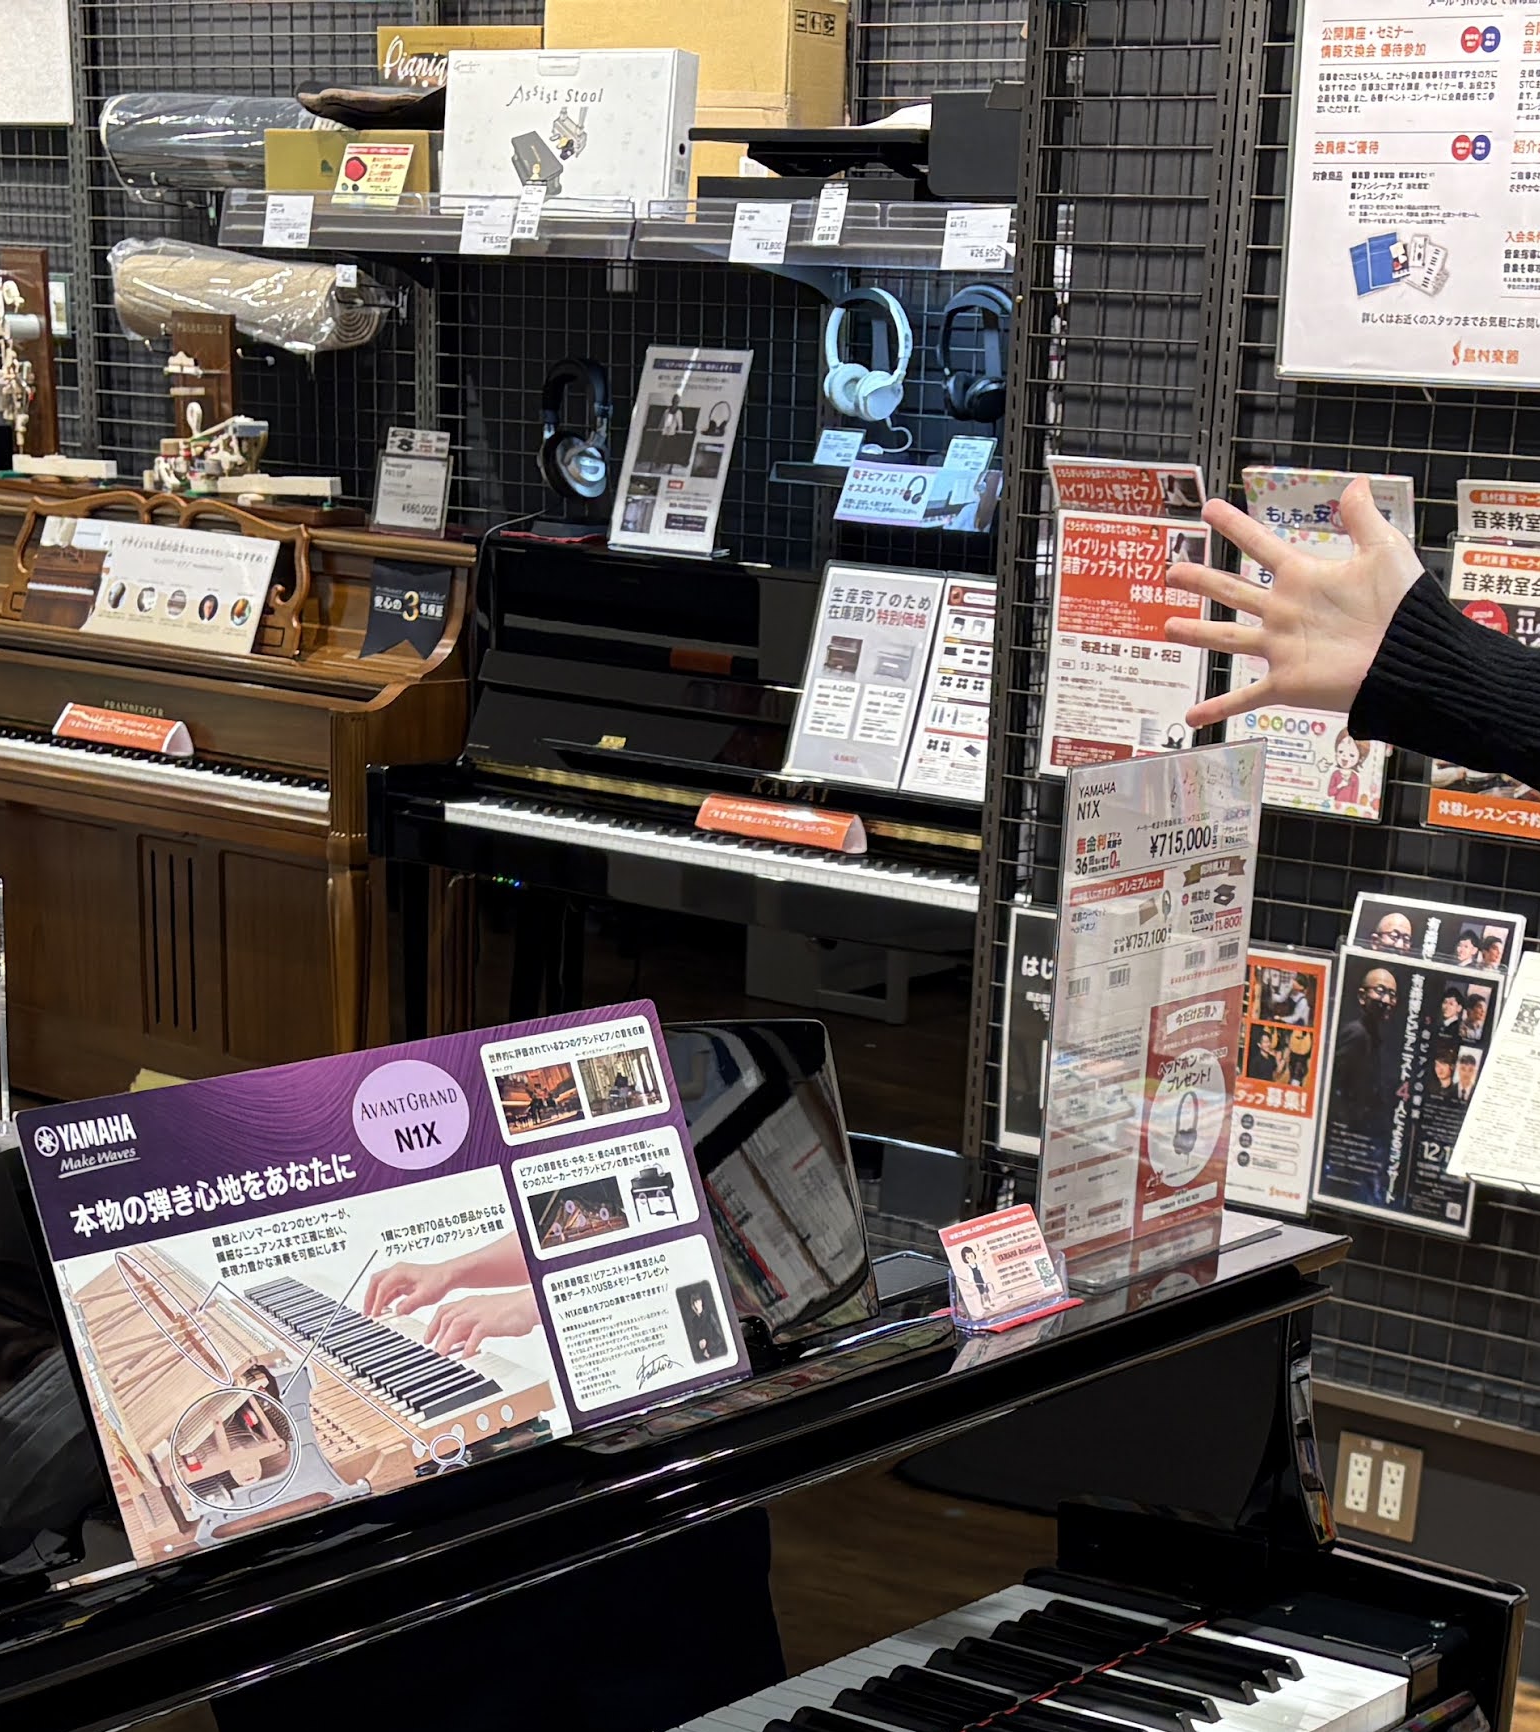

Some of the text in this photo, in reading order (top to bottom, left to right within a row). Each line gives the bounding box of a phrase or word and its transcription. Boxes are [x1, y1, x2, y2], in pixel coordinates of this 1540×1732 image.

[1321, 26, 1414, 41] 公開講座・セミナー
[1320, 43, 1427, 59] 情報交換会 優待参加
[506, 84, 605, 107] Assist Stool
[1314, 140, 1380, 155] 会員様ご優待
[1312, 171, 1344, 182] 対象商品
[1462, 348, 1520, 365] 島村楽器
[829, 586, 932, 612] 生産完了のため
[827, 602, 928, 631] 在庫限り特別価格
[1080, 639, 1182, 664] 毎週土曜・日曜・祝日
[751, 775, 830, 804] KAWAI
[1078, 780, 1117, 798] YAMAHA
[1076, 799, 1101, 822] N1X
[1149, 825, 1212, 860] ¥715,000
[1074, 855, 1088, 876] 36
[1125, 927, 1167, 951] ¥757,100
[487, 1024, 646, 1064] 世界的に評価されている2つのグランドピアノの音を収録
[1167, 1067, 1212, 1093] プレゼント!
[1233, 1085, 1308, 1114] タッフ募集!
[57, 1112, 138, 1154] YAMAHA
[393, 1121, 443, 1155] N1X
[60, 1145, 137, 1173] Make Waves
[522, 1147, 671, 1190] 6つのスピーカーでグランドピアノの豊かな響きを再現
[67, 1151, 358, 1241] 本物の弾き心地をあなたに
[211, 1208, 352, 1247] 鍵盤とハンマーの2つのセンサーが、
[379, 1203, 507, 1243] 1鍵につき約70点もの部品からなる
[215, 1227, 350, 1264] 繊細なニュアンスまで正確に拾い、
[384, 1221, 506, 1258] グランドピアノのアクションを搭載
[219, 1241, 348, 1279] 表現力豊かな演奏を可能にします
[553, 1265, 670, 1305] 演奏データ入りUSBメモリーをプレゼント
